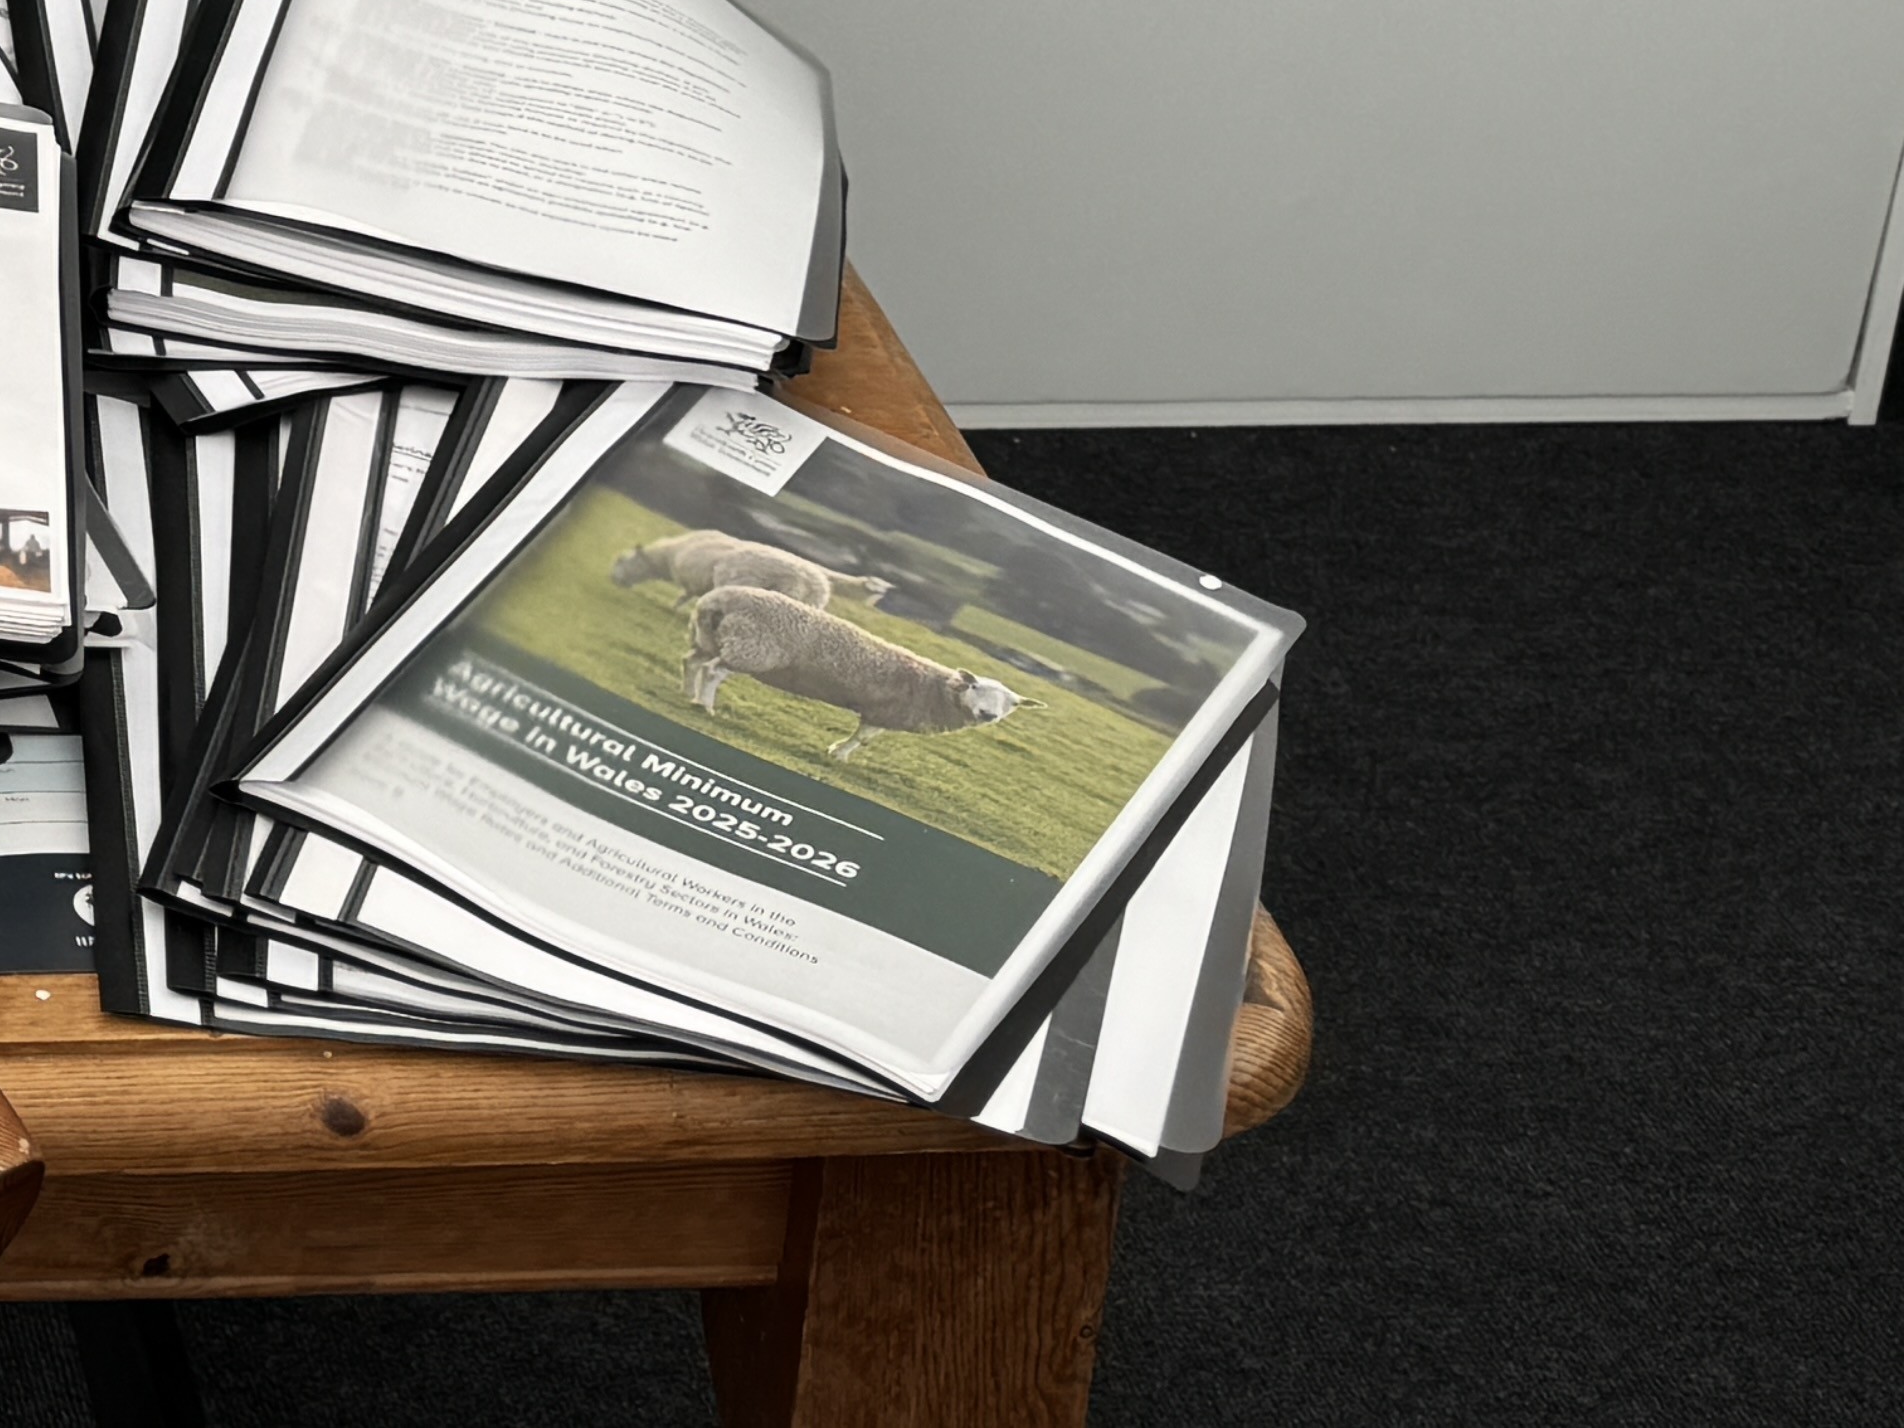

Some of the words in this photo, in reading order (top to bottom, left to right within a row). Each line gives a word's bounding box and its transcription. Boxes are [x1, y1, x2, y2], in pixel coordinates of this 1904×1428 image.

[433, 677, 521, 734] Wage
[524, 724, 557, 755] in
[566, 745, 662, 801] Wales
[668, 792, 861, 880] 2025-2026
[448, 659, 637, 762] Agricultural
[641, 749, 794, 827] Minimum
[587, 838, 678, 885] Agricultural
[681, 877, 748, 911] Workers
[769, 909, 795, 927] the
[590, 852, 658, 891] Forestry
[660, 879, 720, 913] Sectors
[645, 893, 692, 922] Terms
[696, 913, 728, 932] and
[732, 925, 819, 965] Conditions
